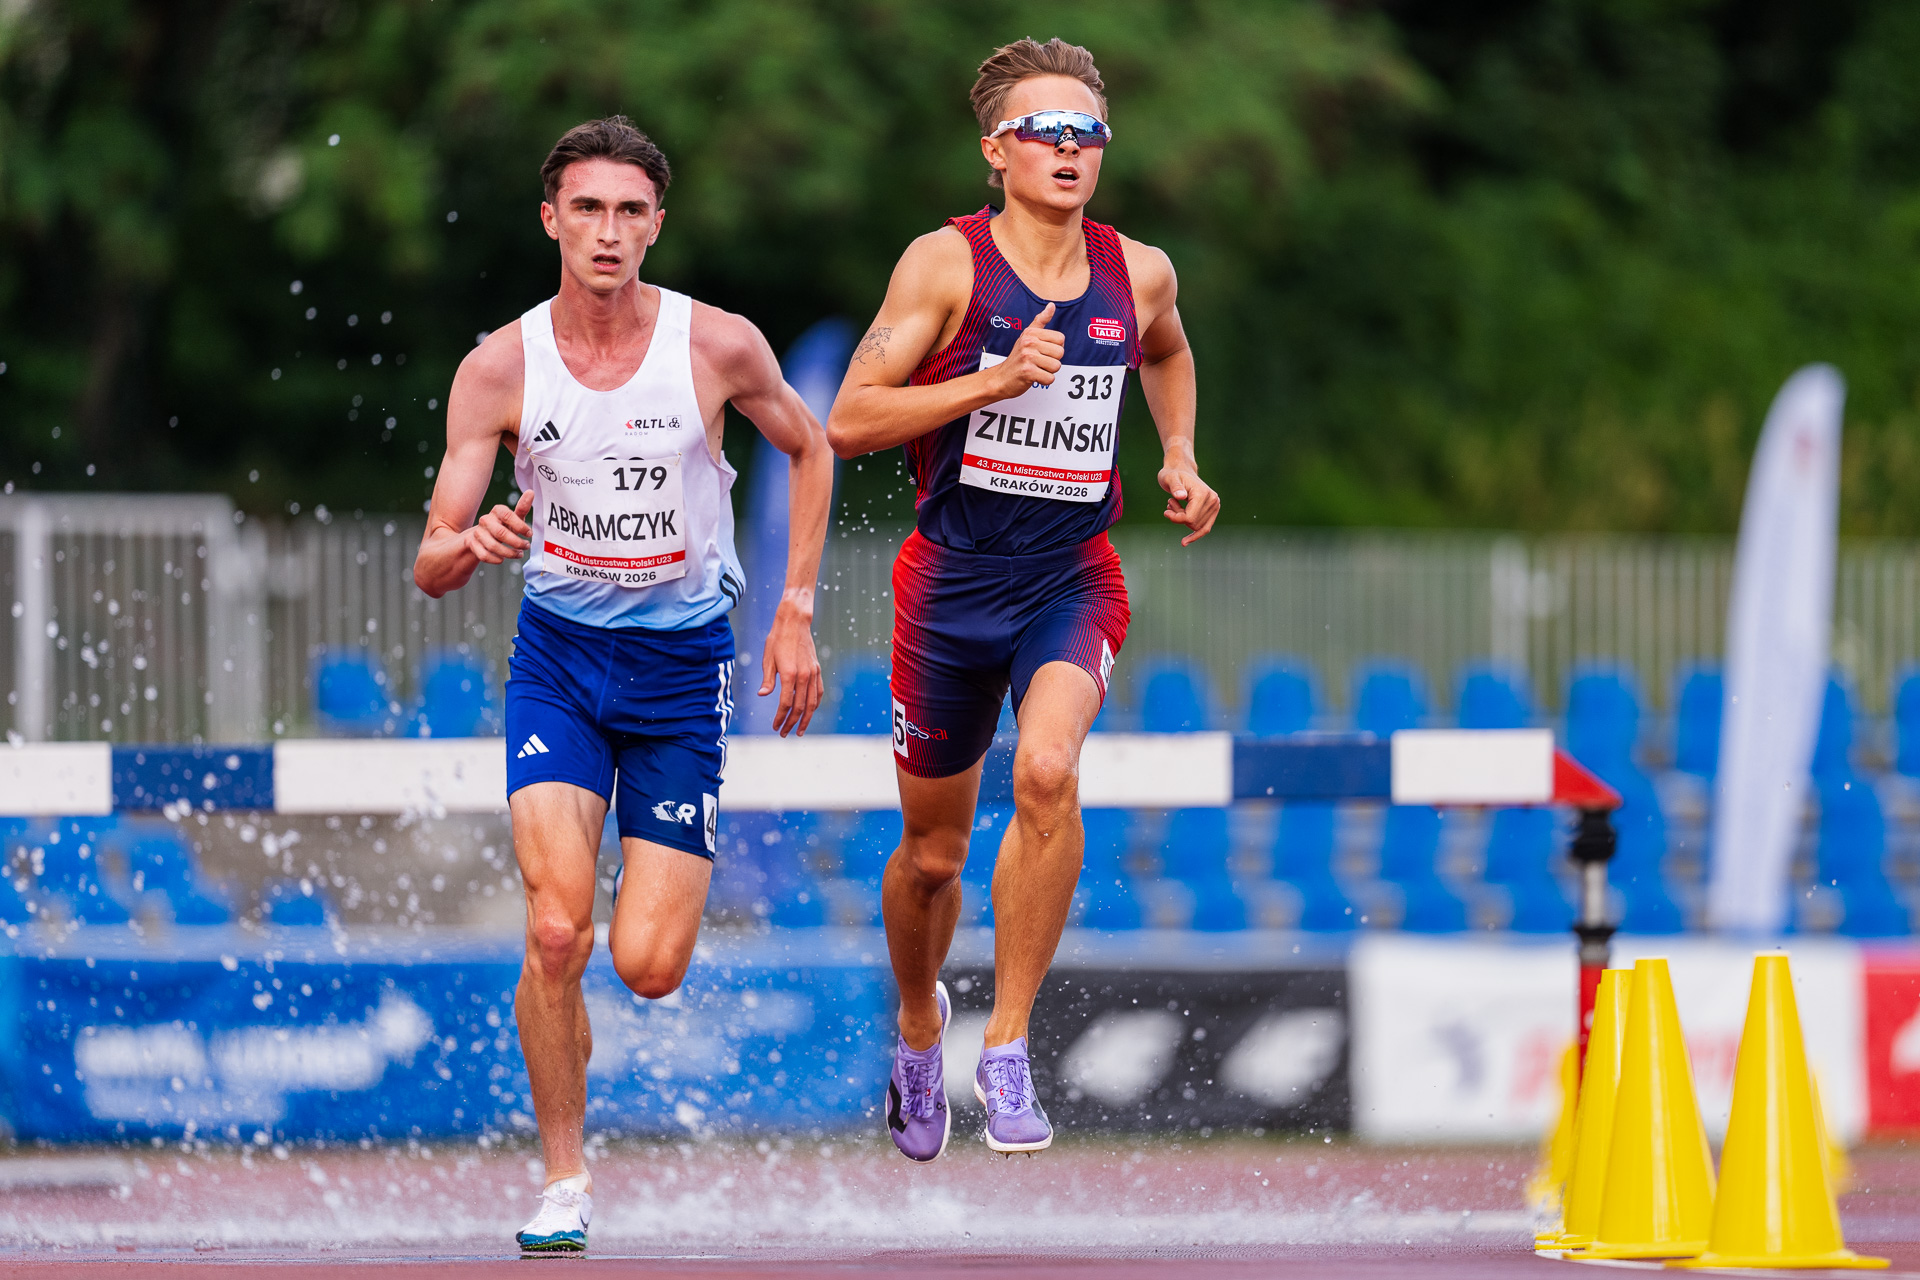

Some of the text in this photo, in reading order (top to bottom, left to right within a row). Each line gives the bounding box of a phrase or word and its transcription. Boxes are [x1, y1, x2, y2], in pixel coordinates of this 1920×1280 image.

[1092, 327, 1122, 338] TALEX
[1067, 374, 1113, 400] 313
[634, 419, 665, 429] RLTL
[974, 410, 1113, 453] ZIELIŃSKI
[562, 476, 594, 486] Okęcie
[612, 466, 667, 491] 179
[977, 459, 1103, 481] 43. PZLA Mistrzostwa Polski U23
[990, 476, 1088, 497] KRAKÓW 2026
[548, 502, 677, 541] ABRAMCZYK
[554, 547, 673, 568] 43. PZLA Mistrzostwa Polski U23
[566, 565, 657, 583] KRAKÓW 2026
[895, 708, 905, 746] 5
[706, 806, 714, 842] 4
